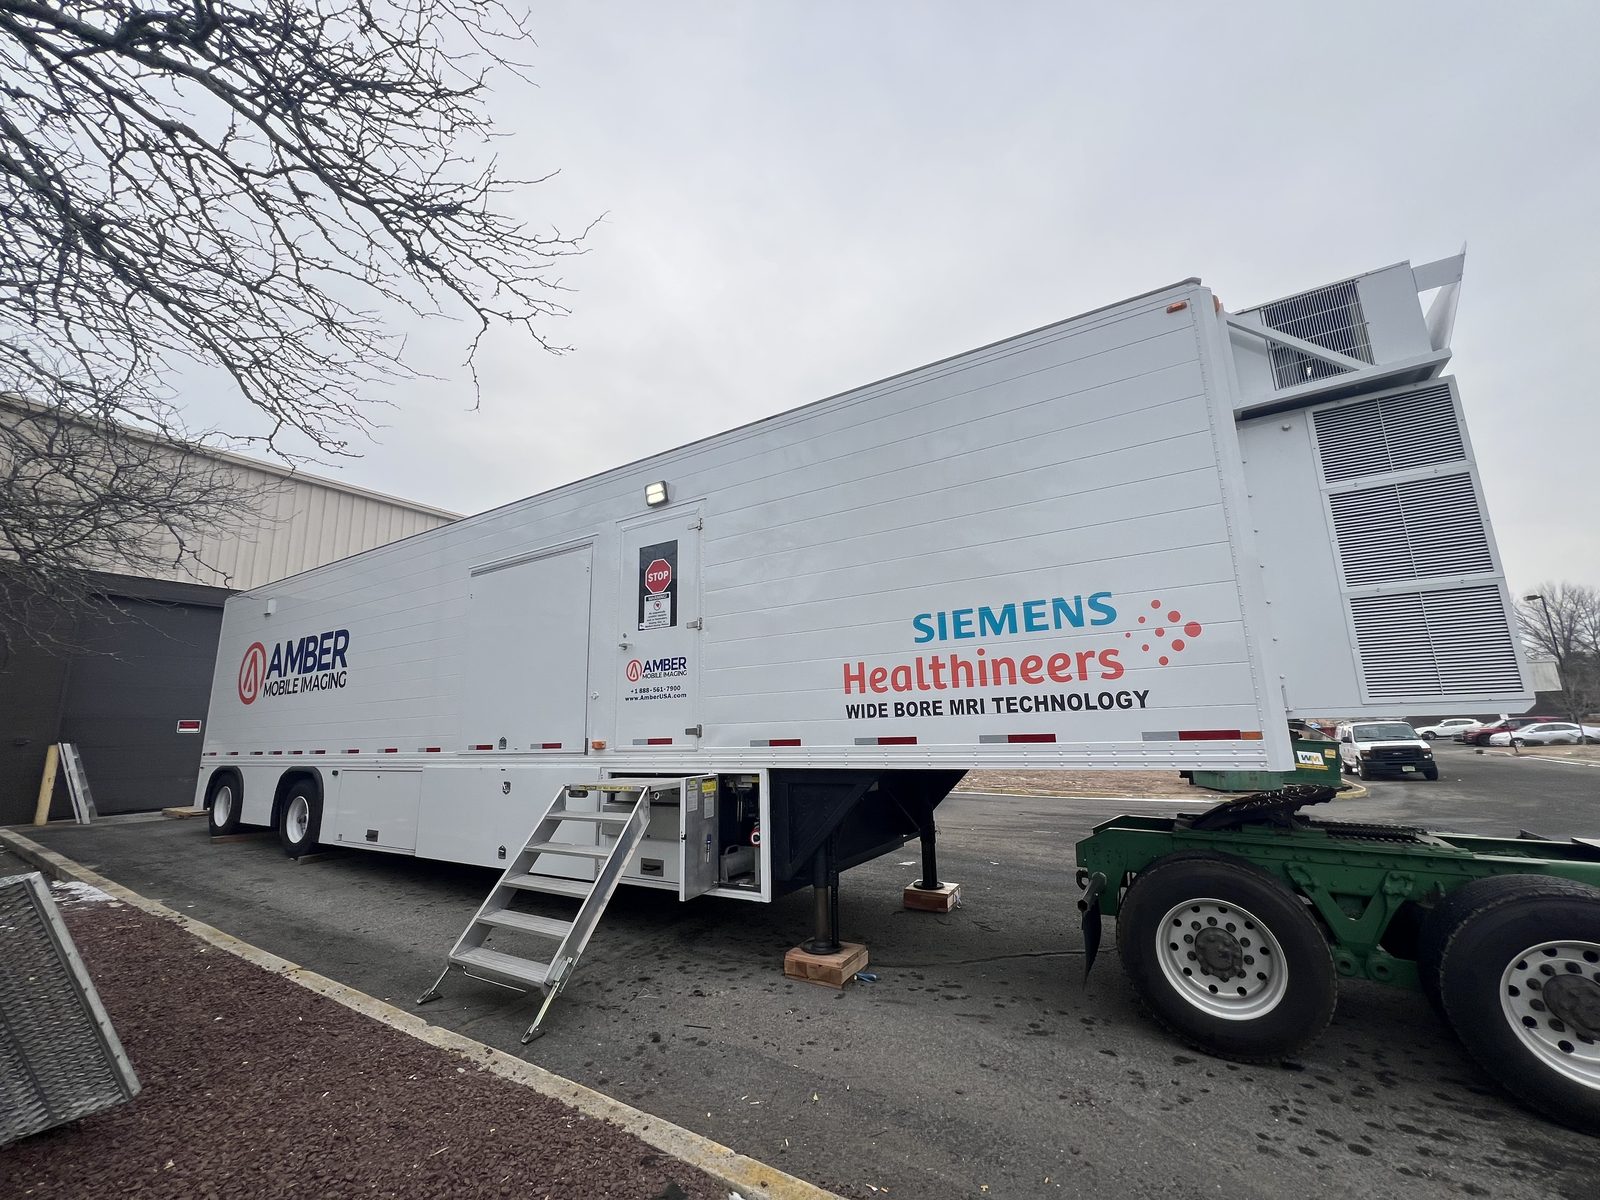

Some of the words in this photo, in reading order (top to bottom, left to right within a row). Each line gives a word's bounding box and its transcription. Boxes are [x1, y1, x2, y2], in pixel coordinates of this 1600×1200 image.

[648, 570, 669, 583] STOP
[912, 591, 1118, 643] SIEMENS
[266, 629, 350, 680] AMBER
[643, 656, 687, 673] AMBER
[263, 677, 299, 697] MOBILE
[301, 671, 347, 692] IMAGING
[843, 648, 1125, 695] Healthineers
[625, 693, 687, 701] www.AmberUSA.com
[846, 703, 889, 720] WIDE
[893, 699, 944, 718] BORE
[949, 698, 985, 716] MRI
[991, 689, 1150, 714] TECHNOLOGY
[1301, 754, 1320, 762] WM
